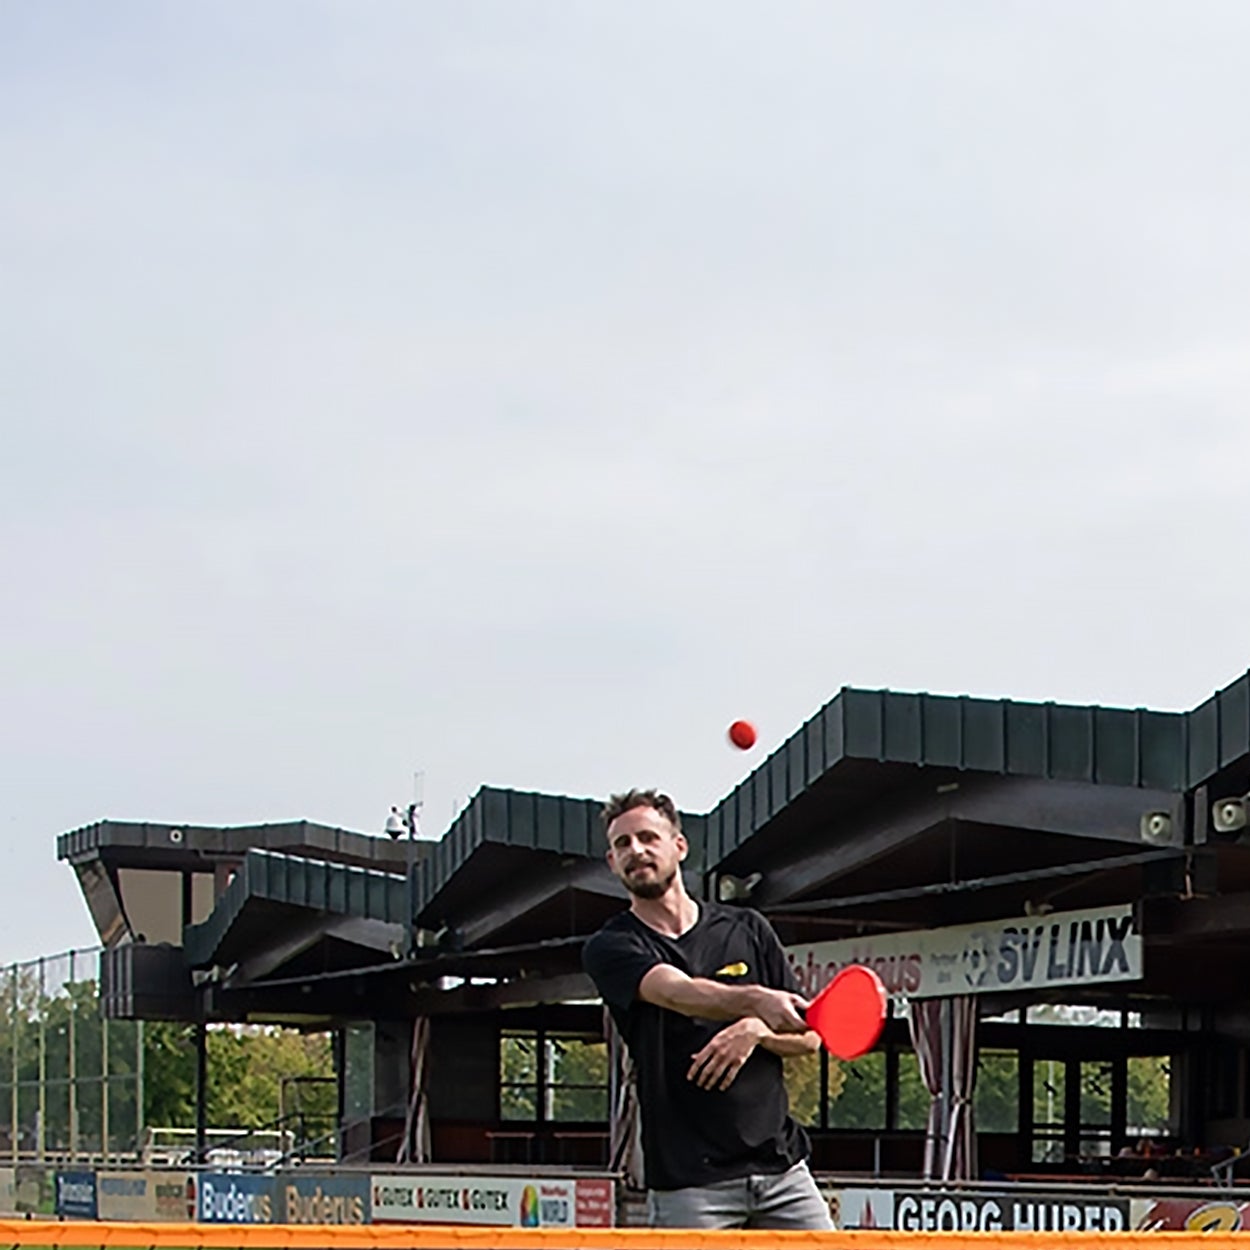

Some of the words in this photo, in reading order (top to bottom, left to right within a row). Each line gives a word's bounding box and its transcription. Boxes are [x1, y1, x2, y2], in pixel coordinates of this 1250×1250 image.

[997, 925, 1044, 983] SV
[1047, 916, 1133, 980] LINX
[202, 1182, 272, 1222] Buderus
[286, 1185, 364, 1224] Buderus
[898, 1196, 1003, 1232] GEORG
